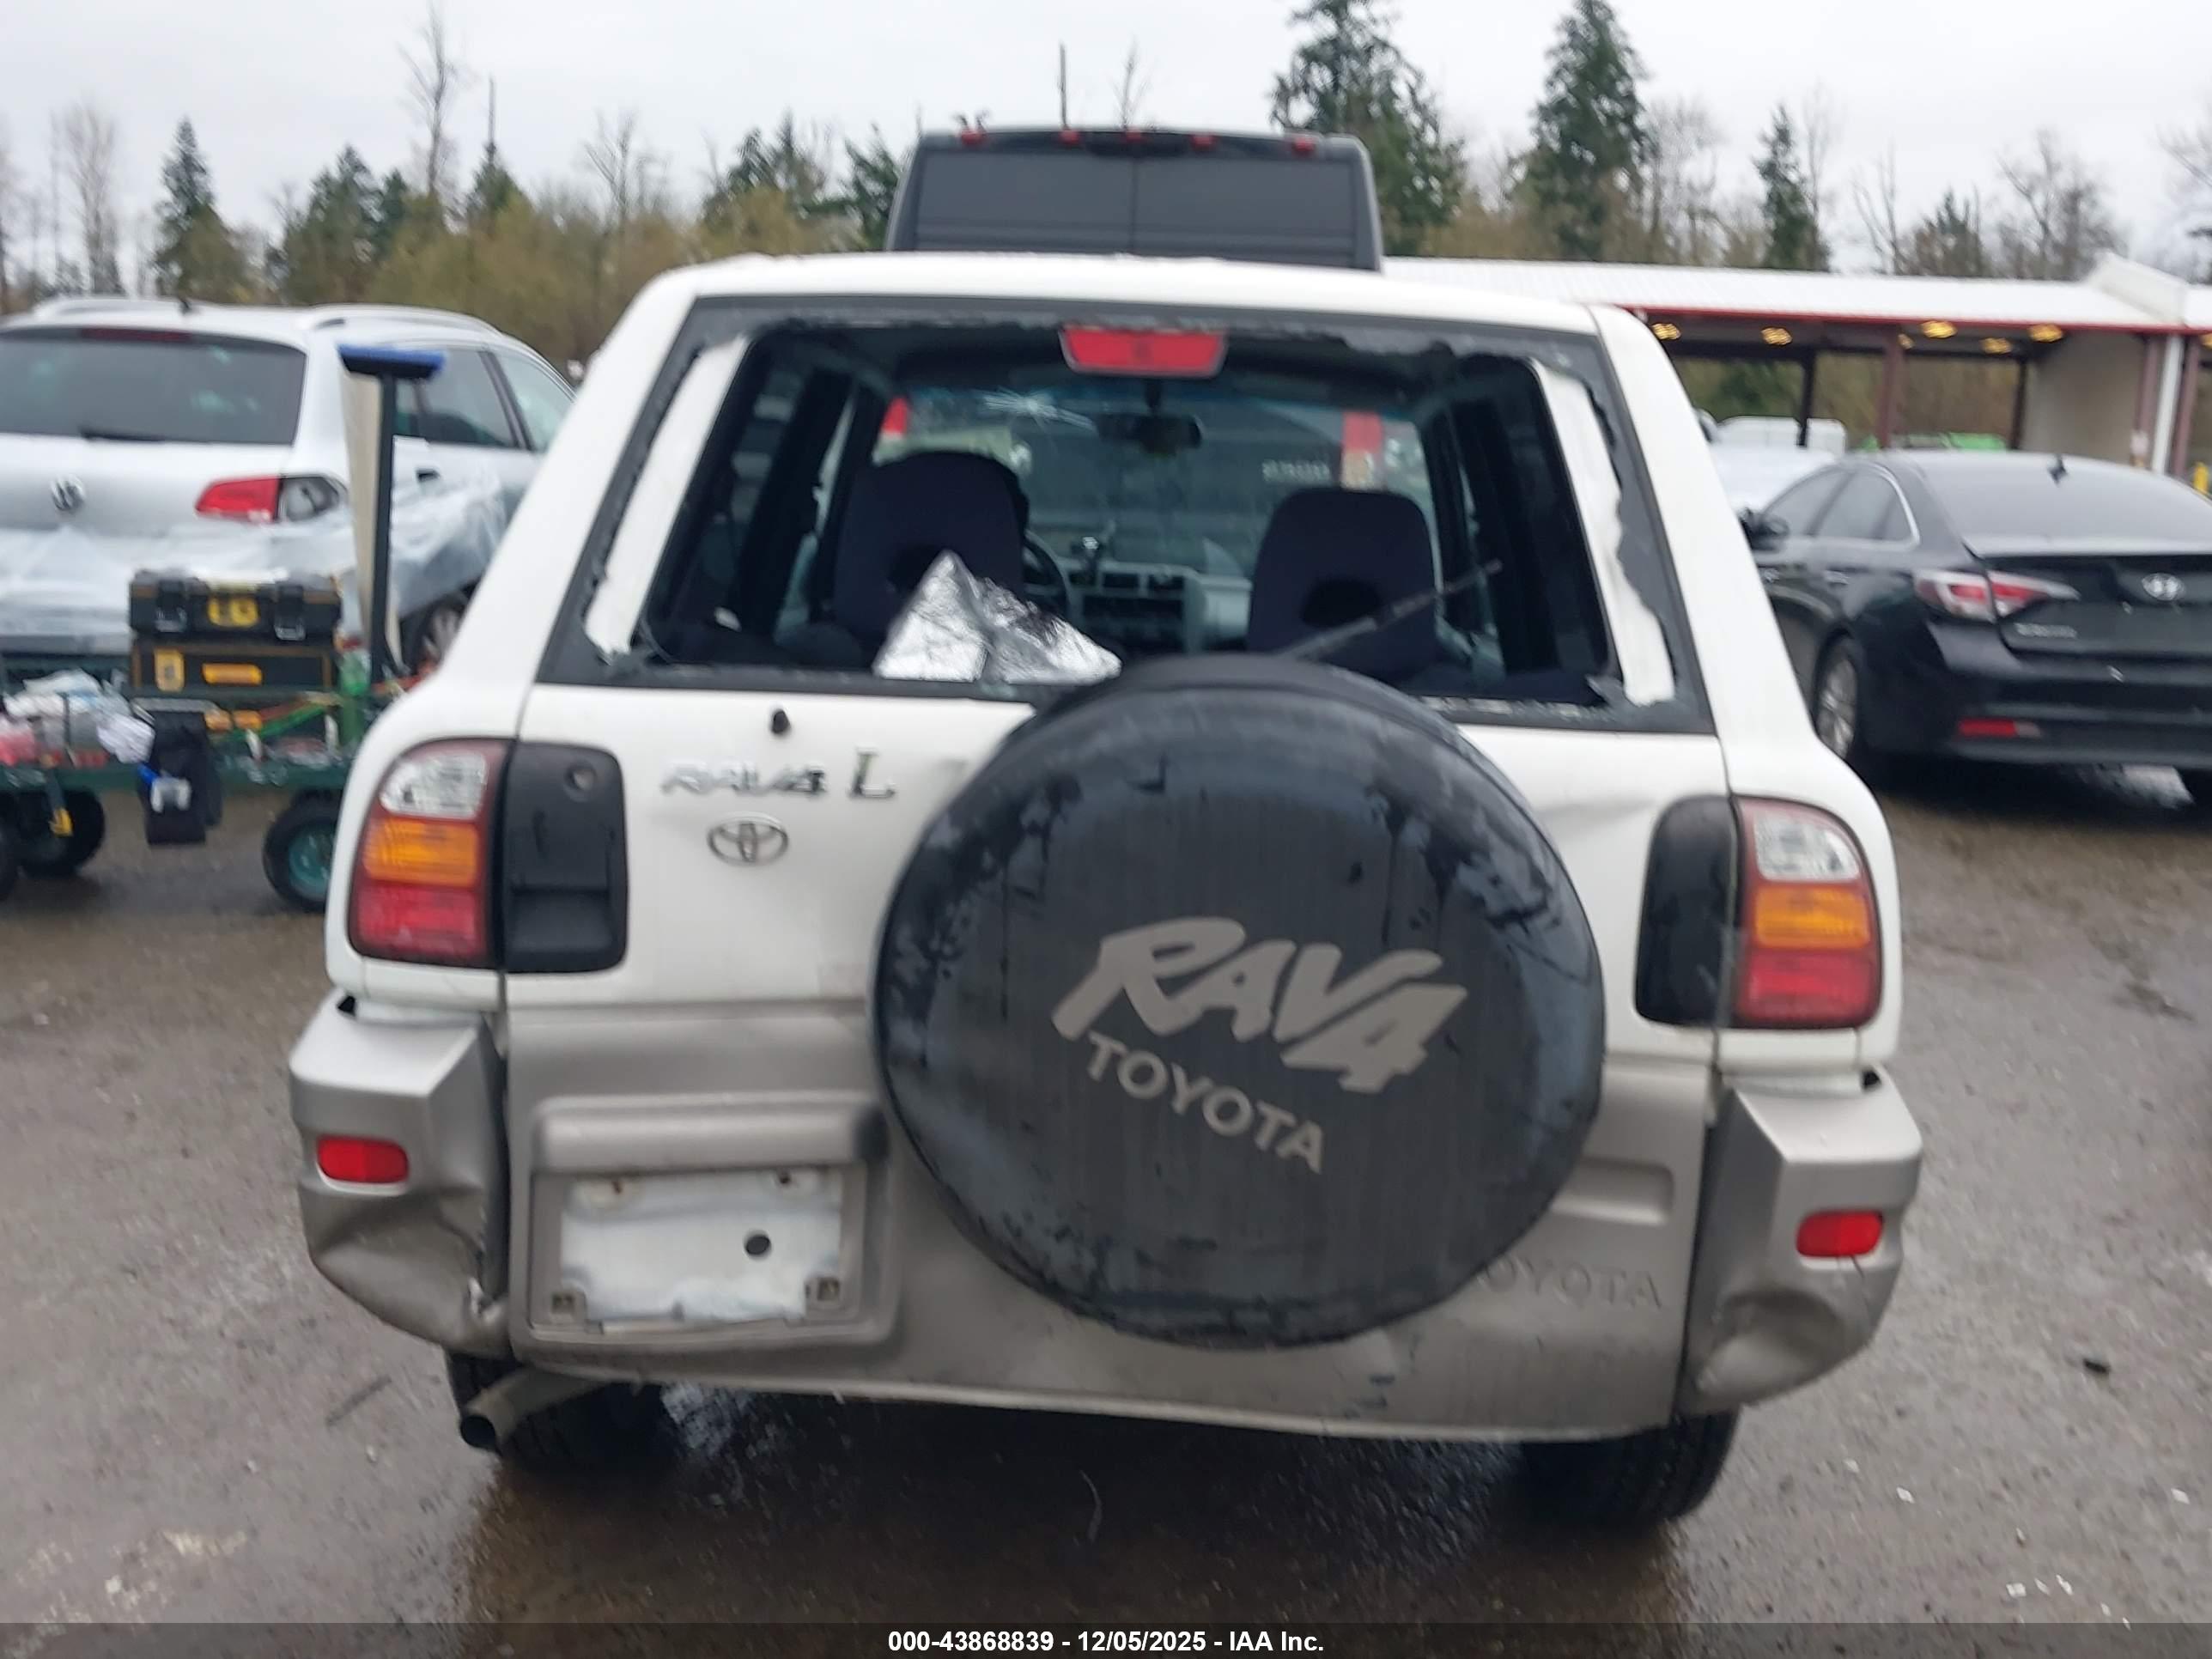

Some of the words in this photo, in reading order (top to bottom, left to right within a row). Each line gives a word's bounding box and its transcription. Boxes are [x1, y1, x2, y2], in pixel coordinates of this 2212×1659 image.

[848, 745, 896, 799] L
[1051, 916, 1467, 1094] RAV4
[1086, 1030, 1323, 1175] TOYOTA
[1476, 1254, 1662, 1310] OYOTA
